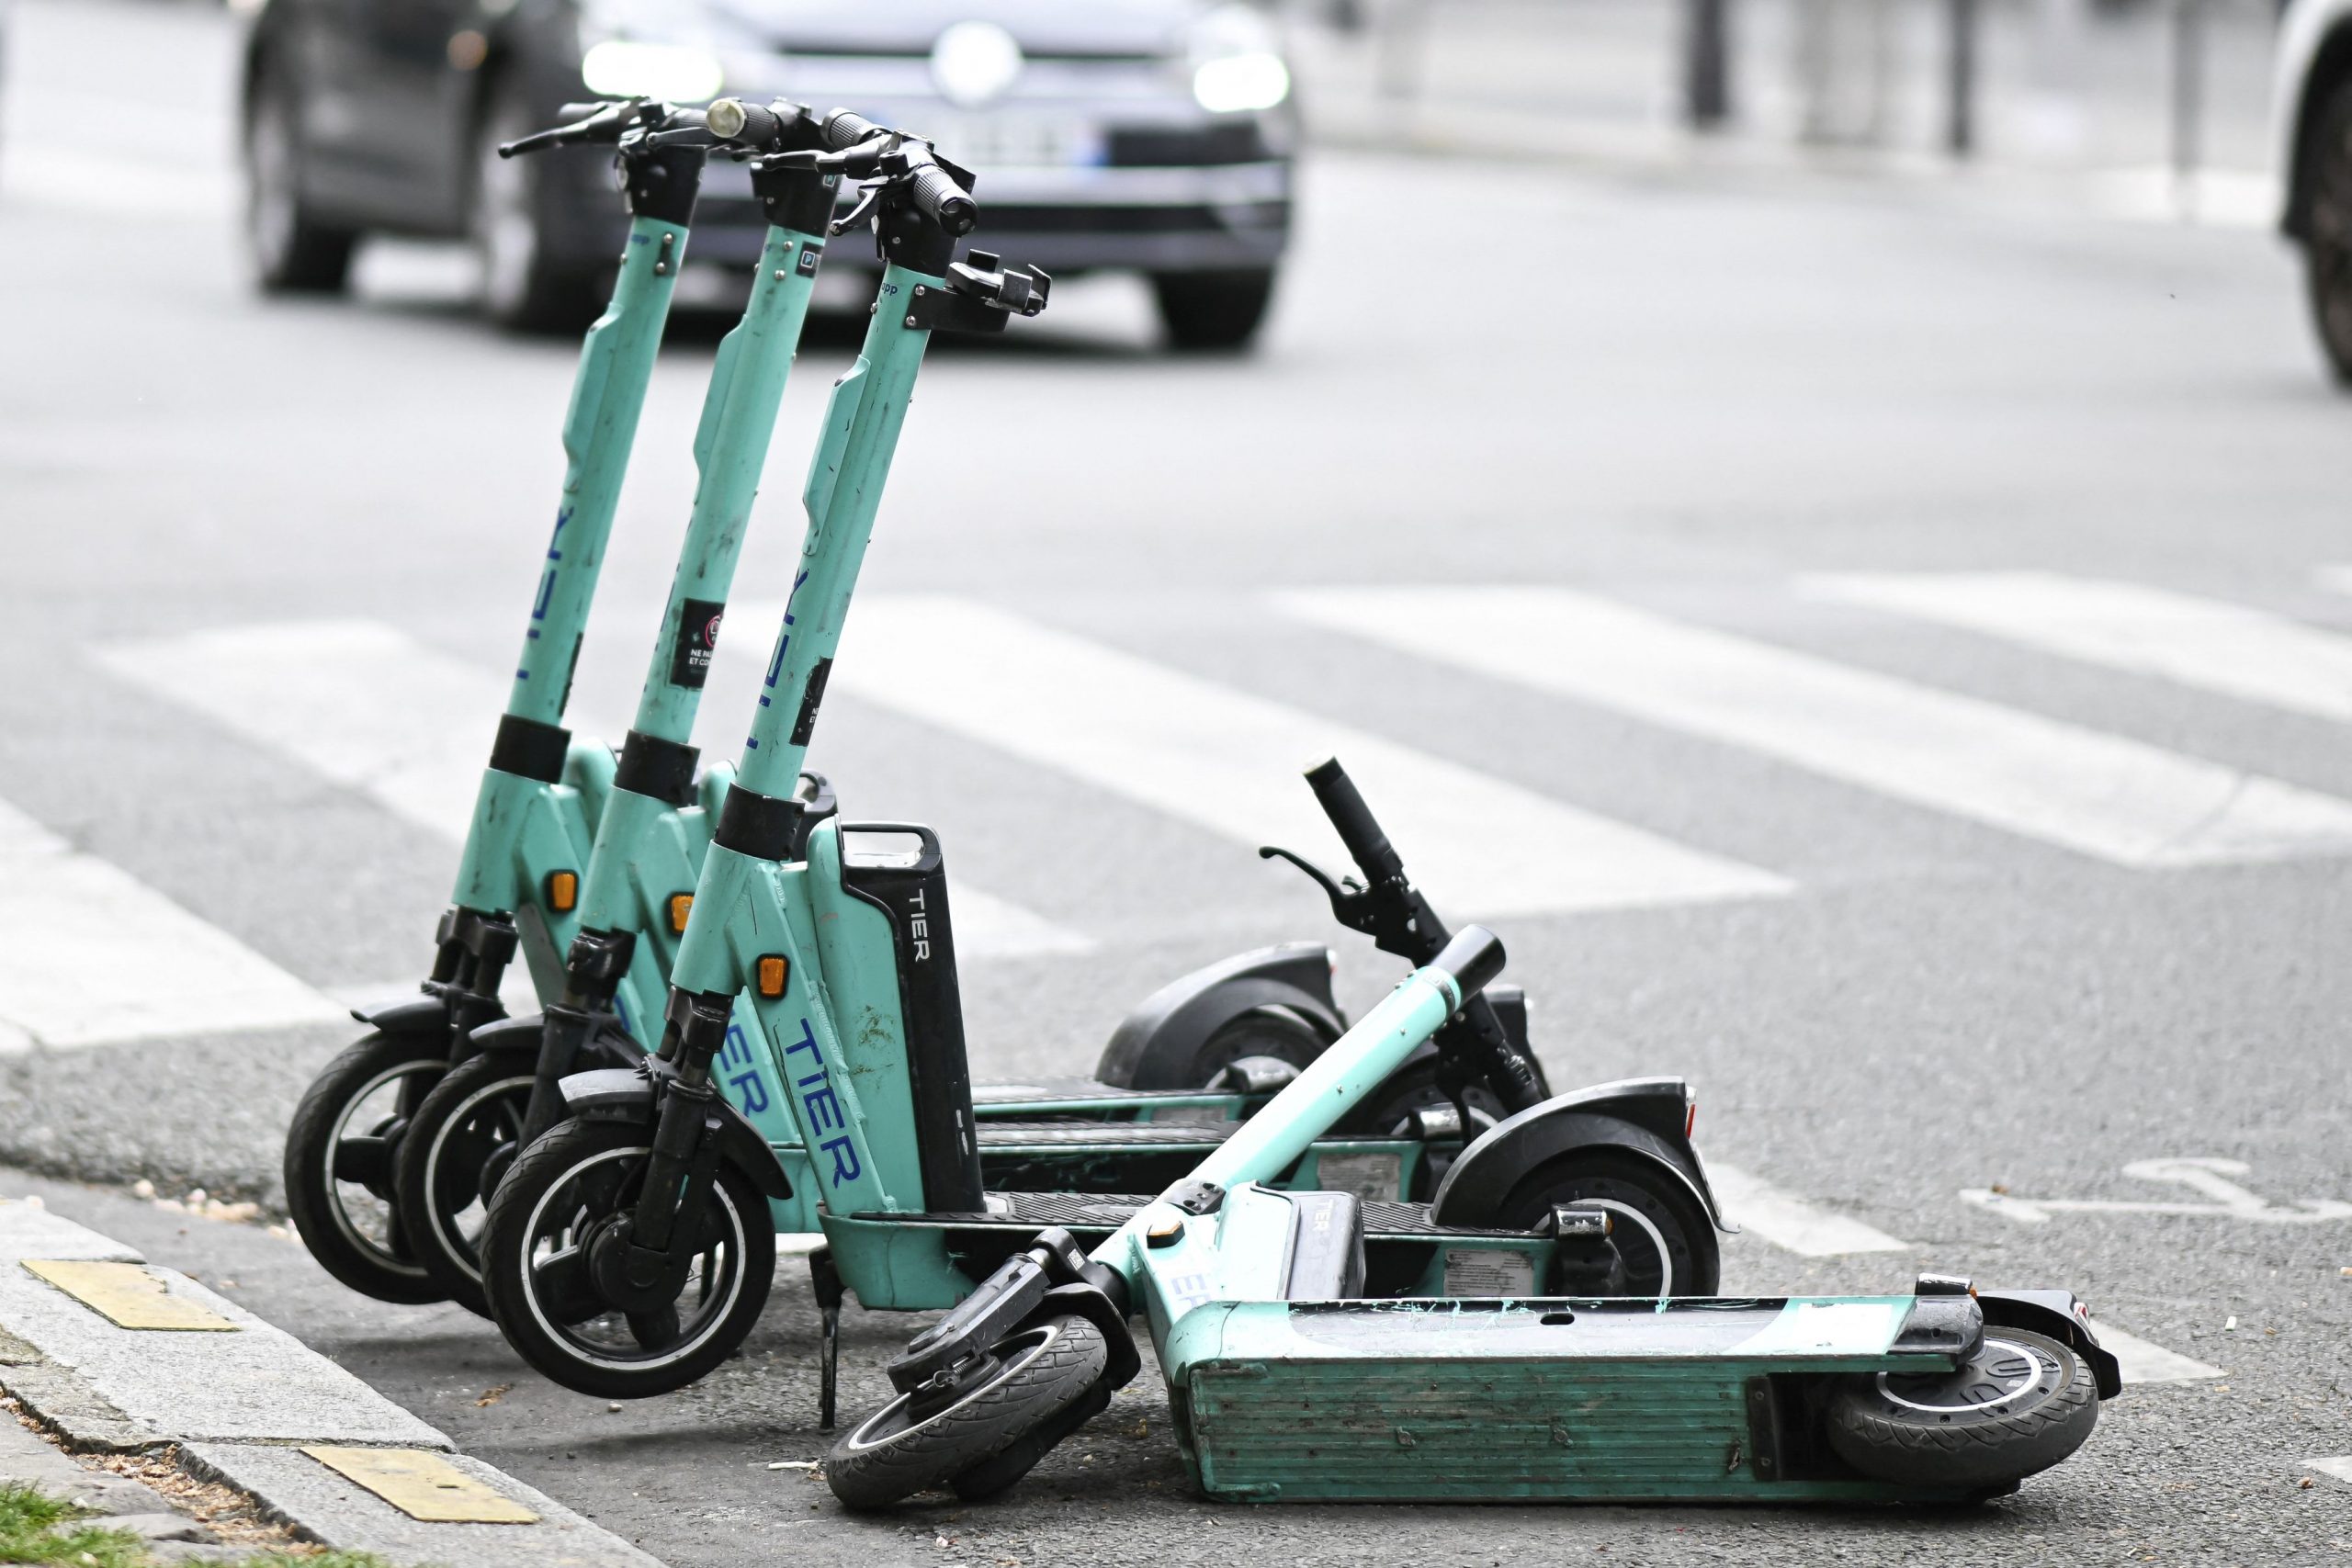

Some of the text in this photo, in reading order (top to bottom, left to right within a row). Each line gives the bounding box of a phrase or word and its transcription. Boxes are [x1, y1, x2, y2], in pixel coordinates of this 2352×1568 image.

[689, 657, 698, 665] ET
[690, 649, 702, 657] NE
[909, 888, 930, 962] TIER
[720, 1010, 769, 1117] ER
[785, 1018, 860, 1189] TIER
[1313, 1199, 1333, 1231] TIER
